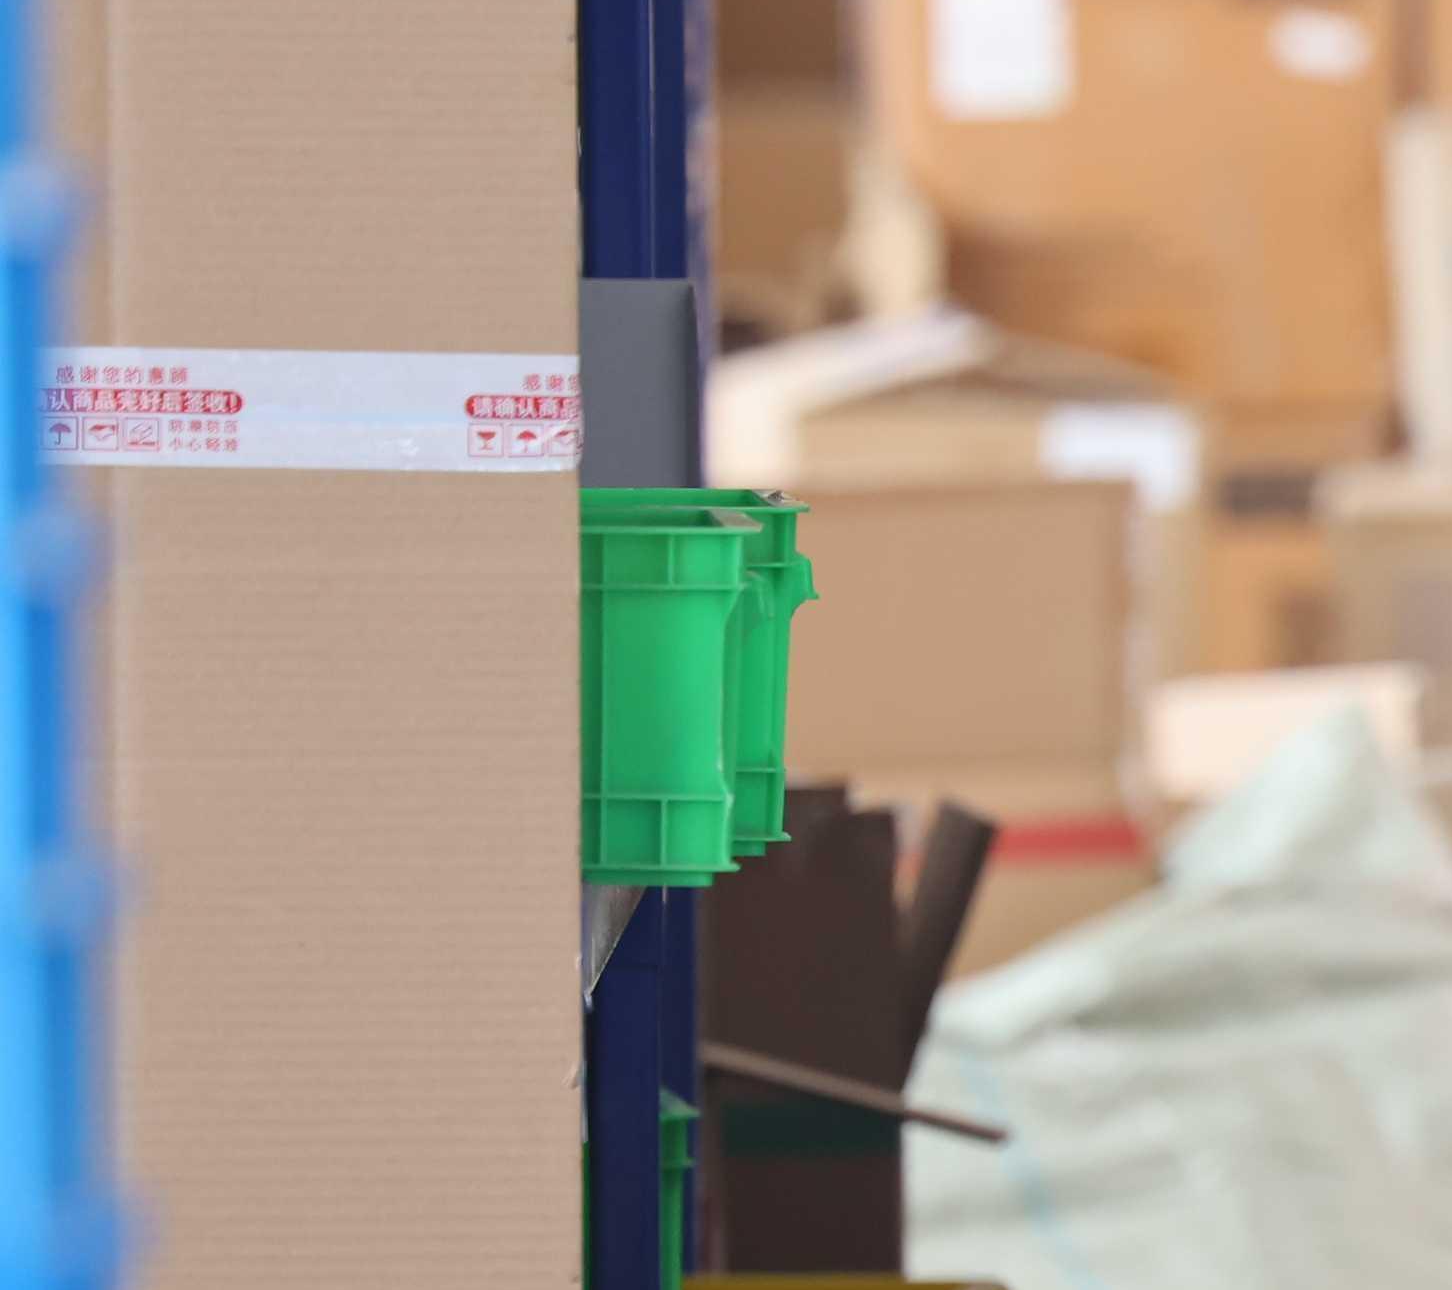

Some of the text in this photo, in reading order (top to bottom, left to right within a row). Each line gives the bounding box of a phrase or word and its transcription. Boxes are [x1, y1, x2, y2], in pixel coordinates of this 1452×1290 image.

[56, 365, 189, 385] 感谢您的惠顾
